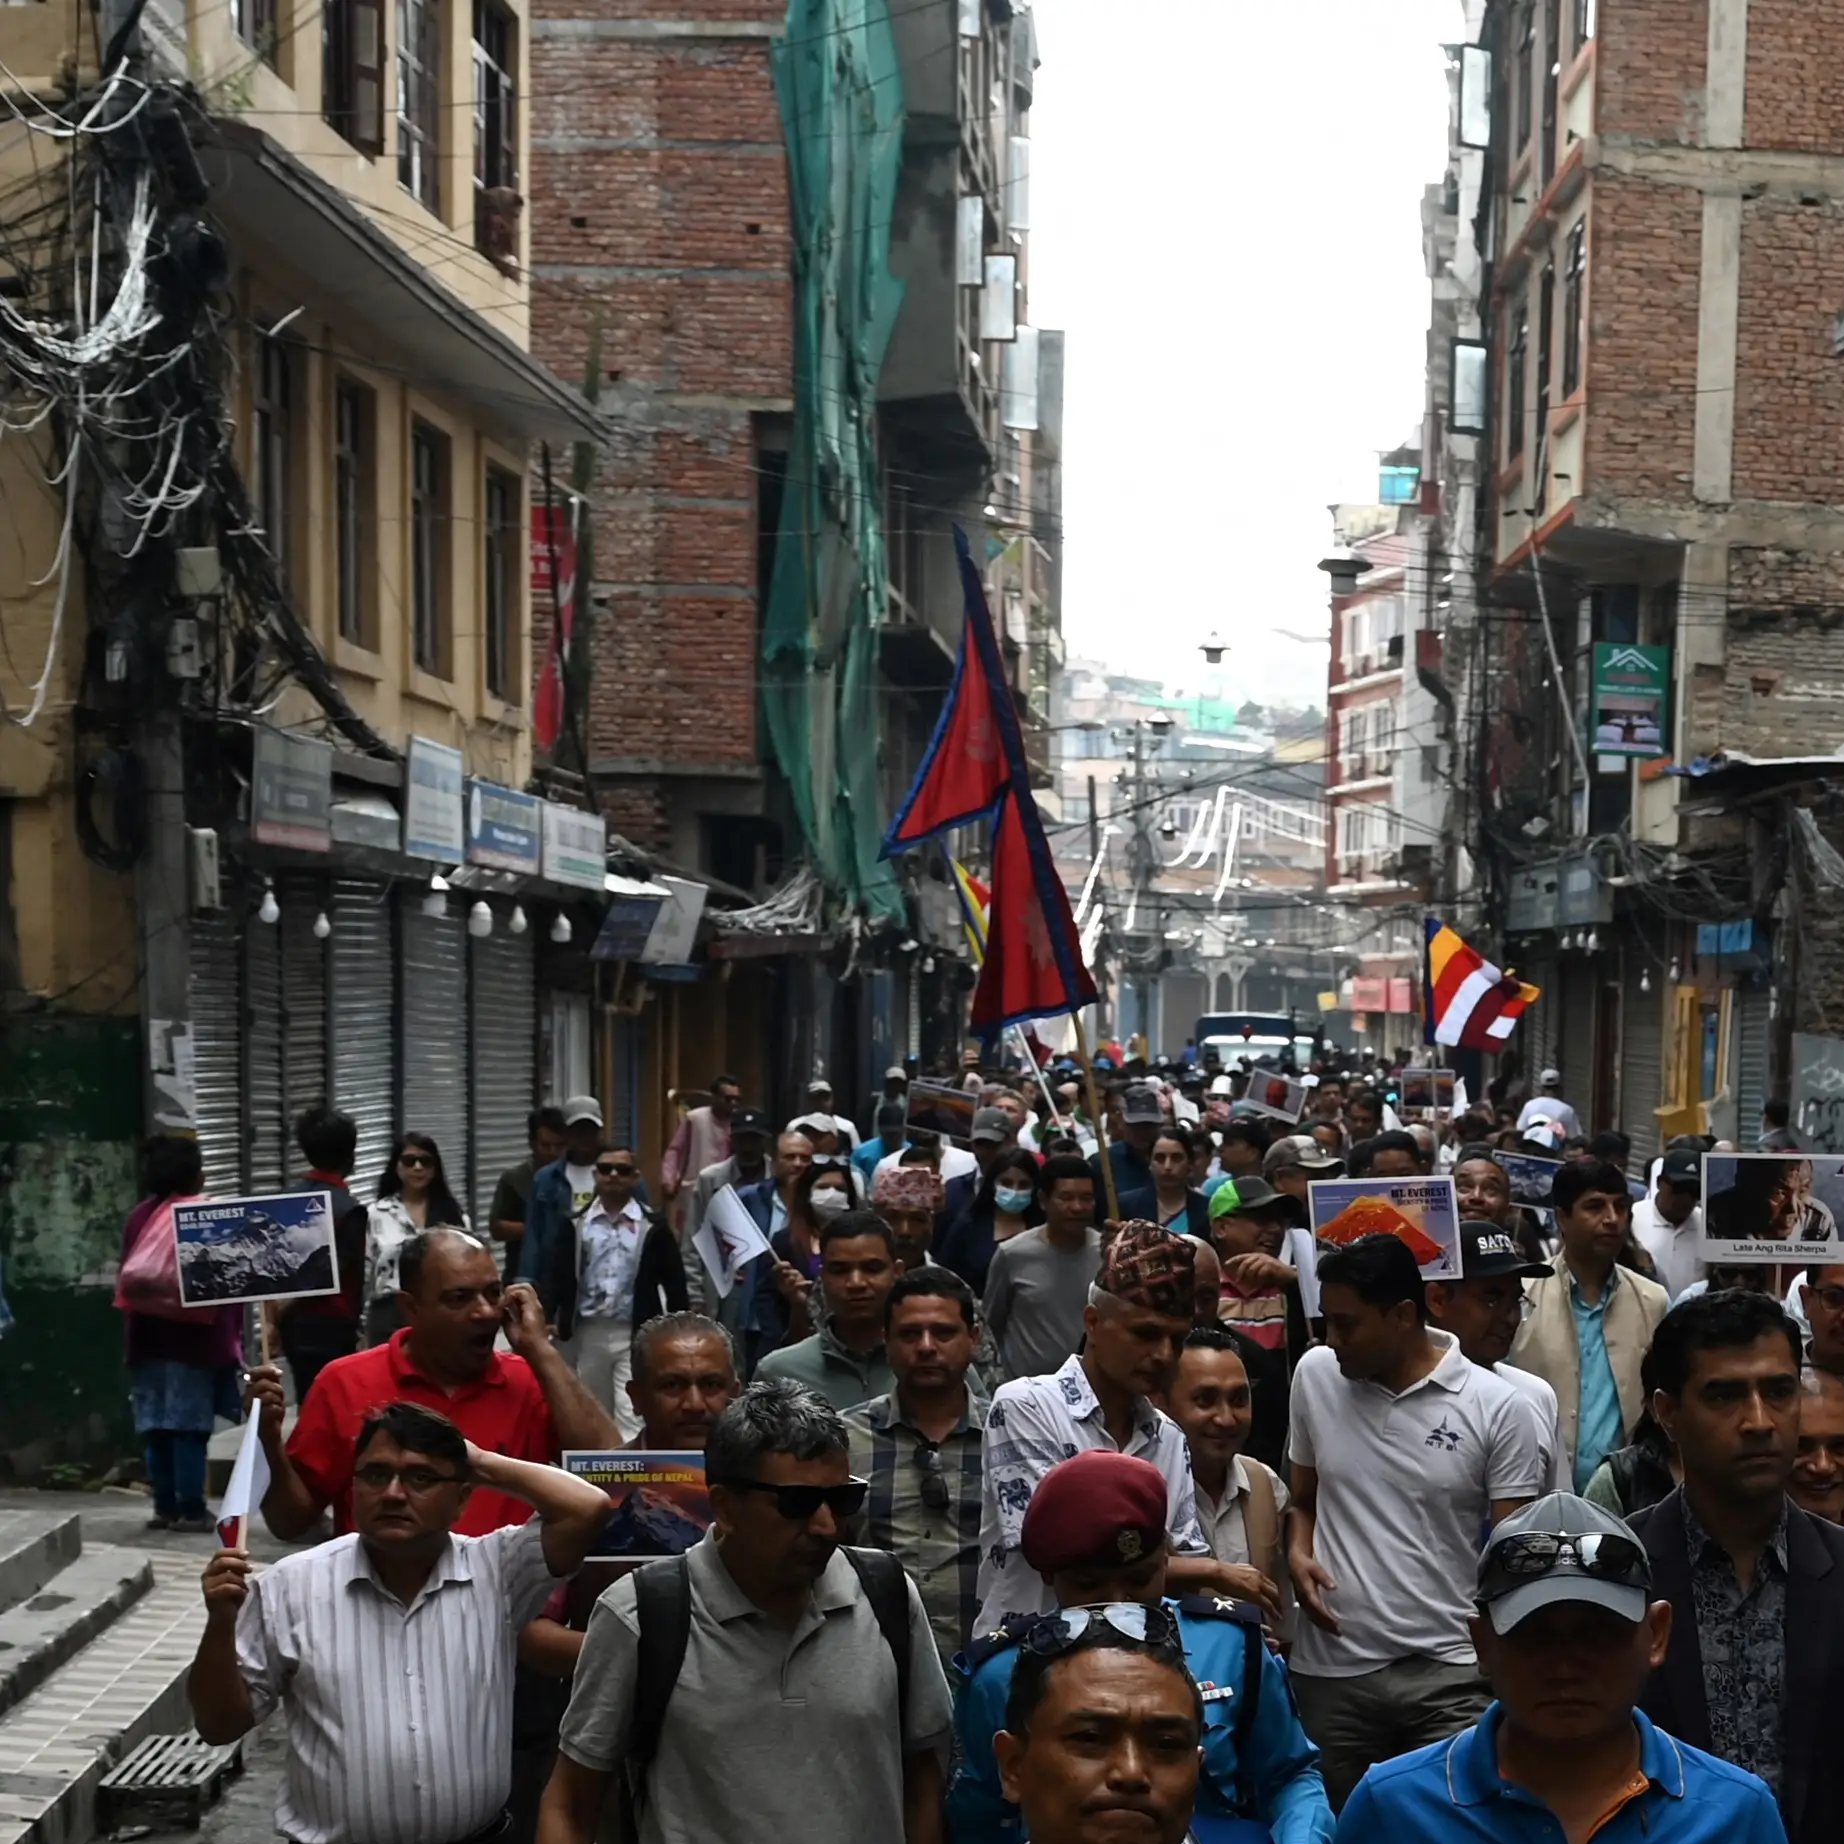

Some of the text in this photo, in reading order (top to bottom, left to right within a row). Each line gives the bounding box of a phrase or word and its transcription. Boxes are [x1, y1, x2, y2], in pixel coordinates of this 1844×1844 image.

[1408, 1186, 1447, 1198] EVEREST
[199, 1206, 246, 1221] EVEREST
[1733, 1243, 1754, 1252] Late
[1755, 1243, 1773, 1255] Ang
[1794, 1244, 1827, 1255] Sherpa
[592, 1460, 645, 1472] EVEREST:
[665, 1472, 695, 1482] NEPAL
